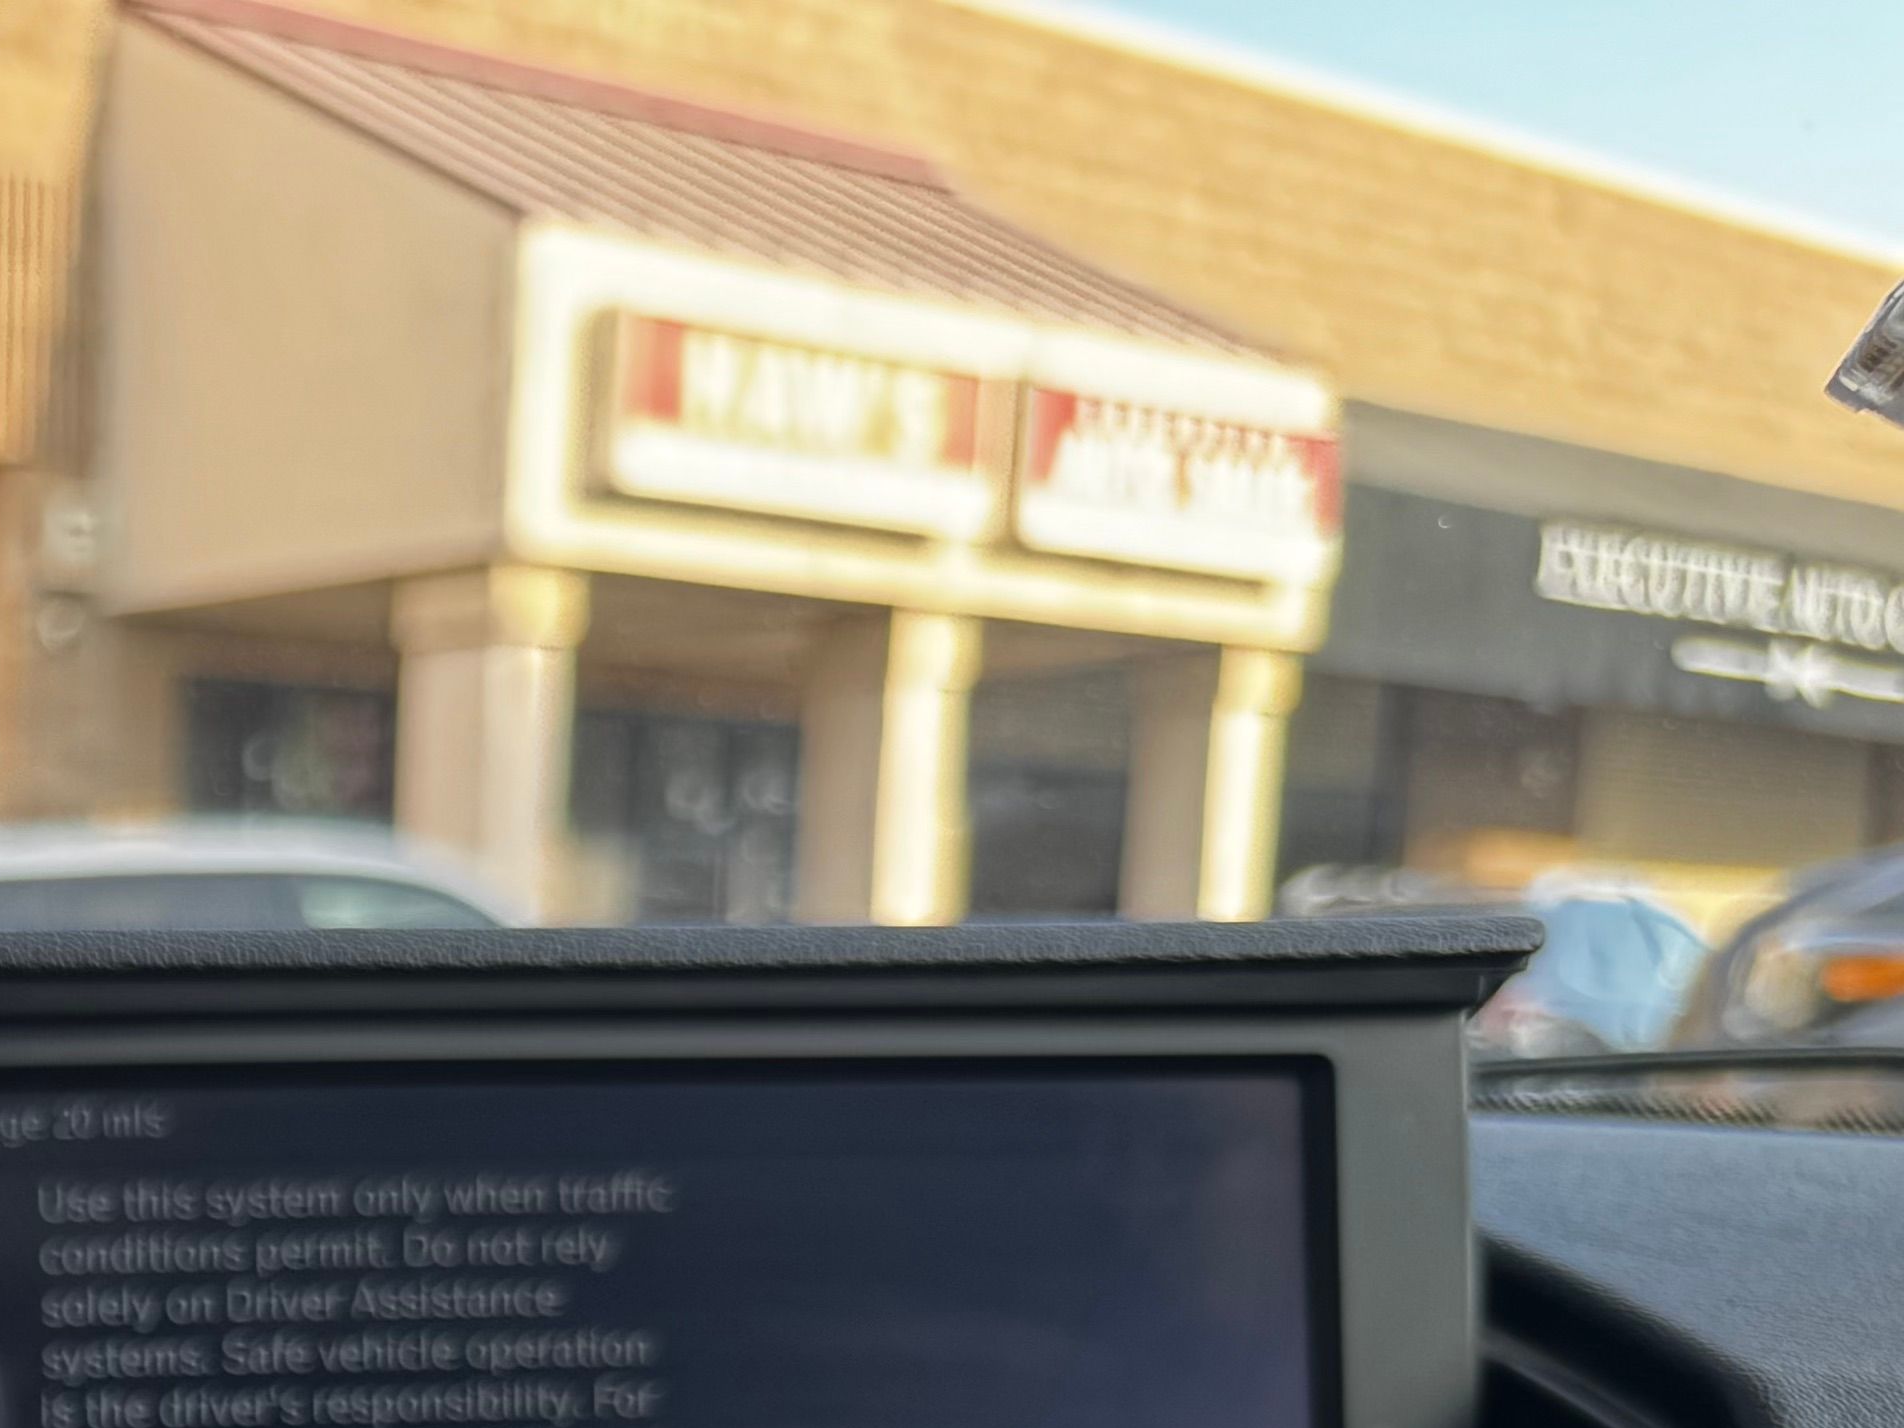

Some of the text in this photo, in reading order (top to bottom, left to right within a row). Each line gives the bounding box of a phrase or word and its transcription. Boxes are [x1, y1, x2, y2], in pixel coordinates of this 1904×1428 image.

[1537, 522, 1783, 634] EXECUTIVE
[39, 1169, 674, 1225] Use this system only when traffic
[39, 1232, 247, 1276] conditions
[404, 1224, 461, 1268] Do
[468, 1227, 528, 1265] not
[542, 1224, 621, 1272] rely
[41, 1278, 567, 1332] solely on Driver Assistance
[222, 1328, 319, 1374] Safe
[319, 1331, 463, 1372] vehicle
[466, 1328, 653, 1376] operation
[86, 1386, 155, 1428] the
[159, 1385, 312, 1428] driver's
[594, 1376, 659, 1420] For
